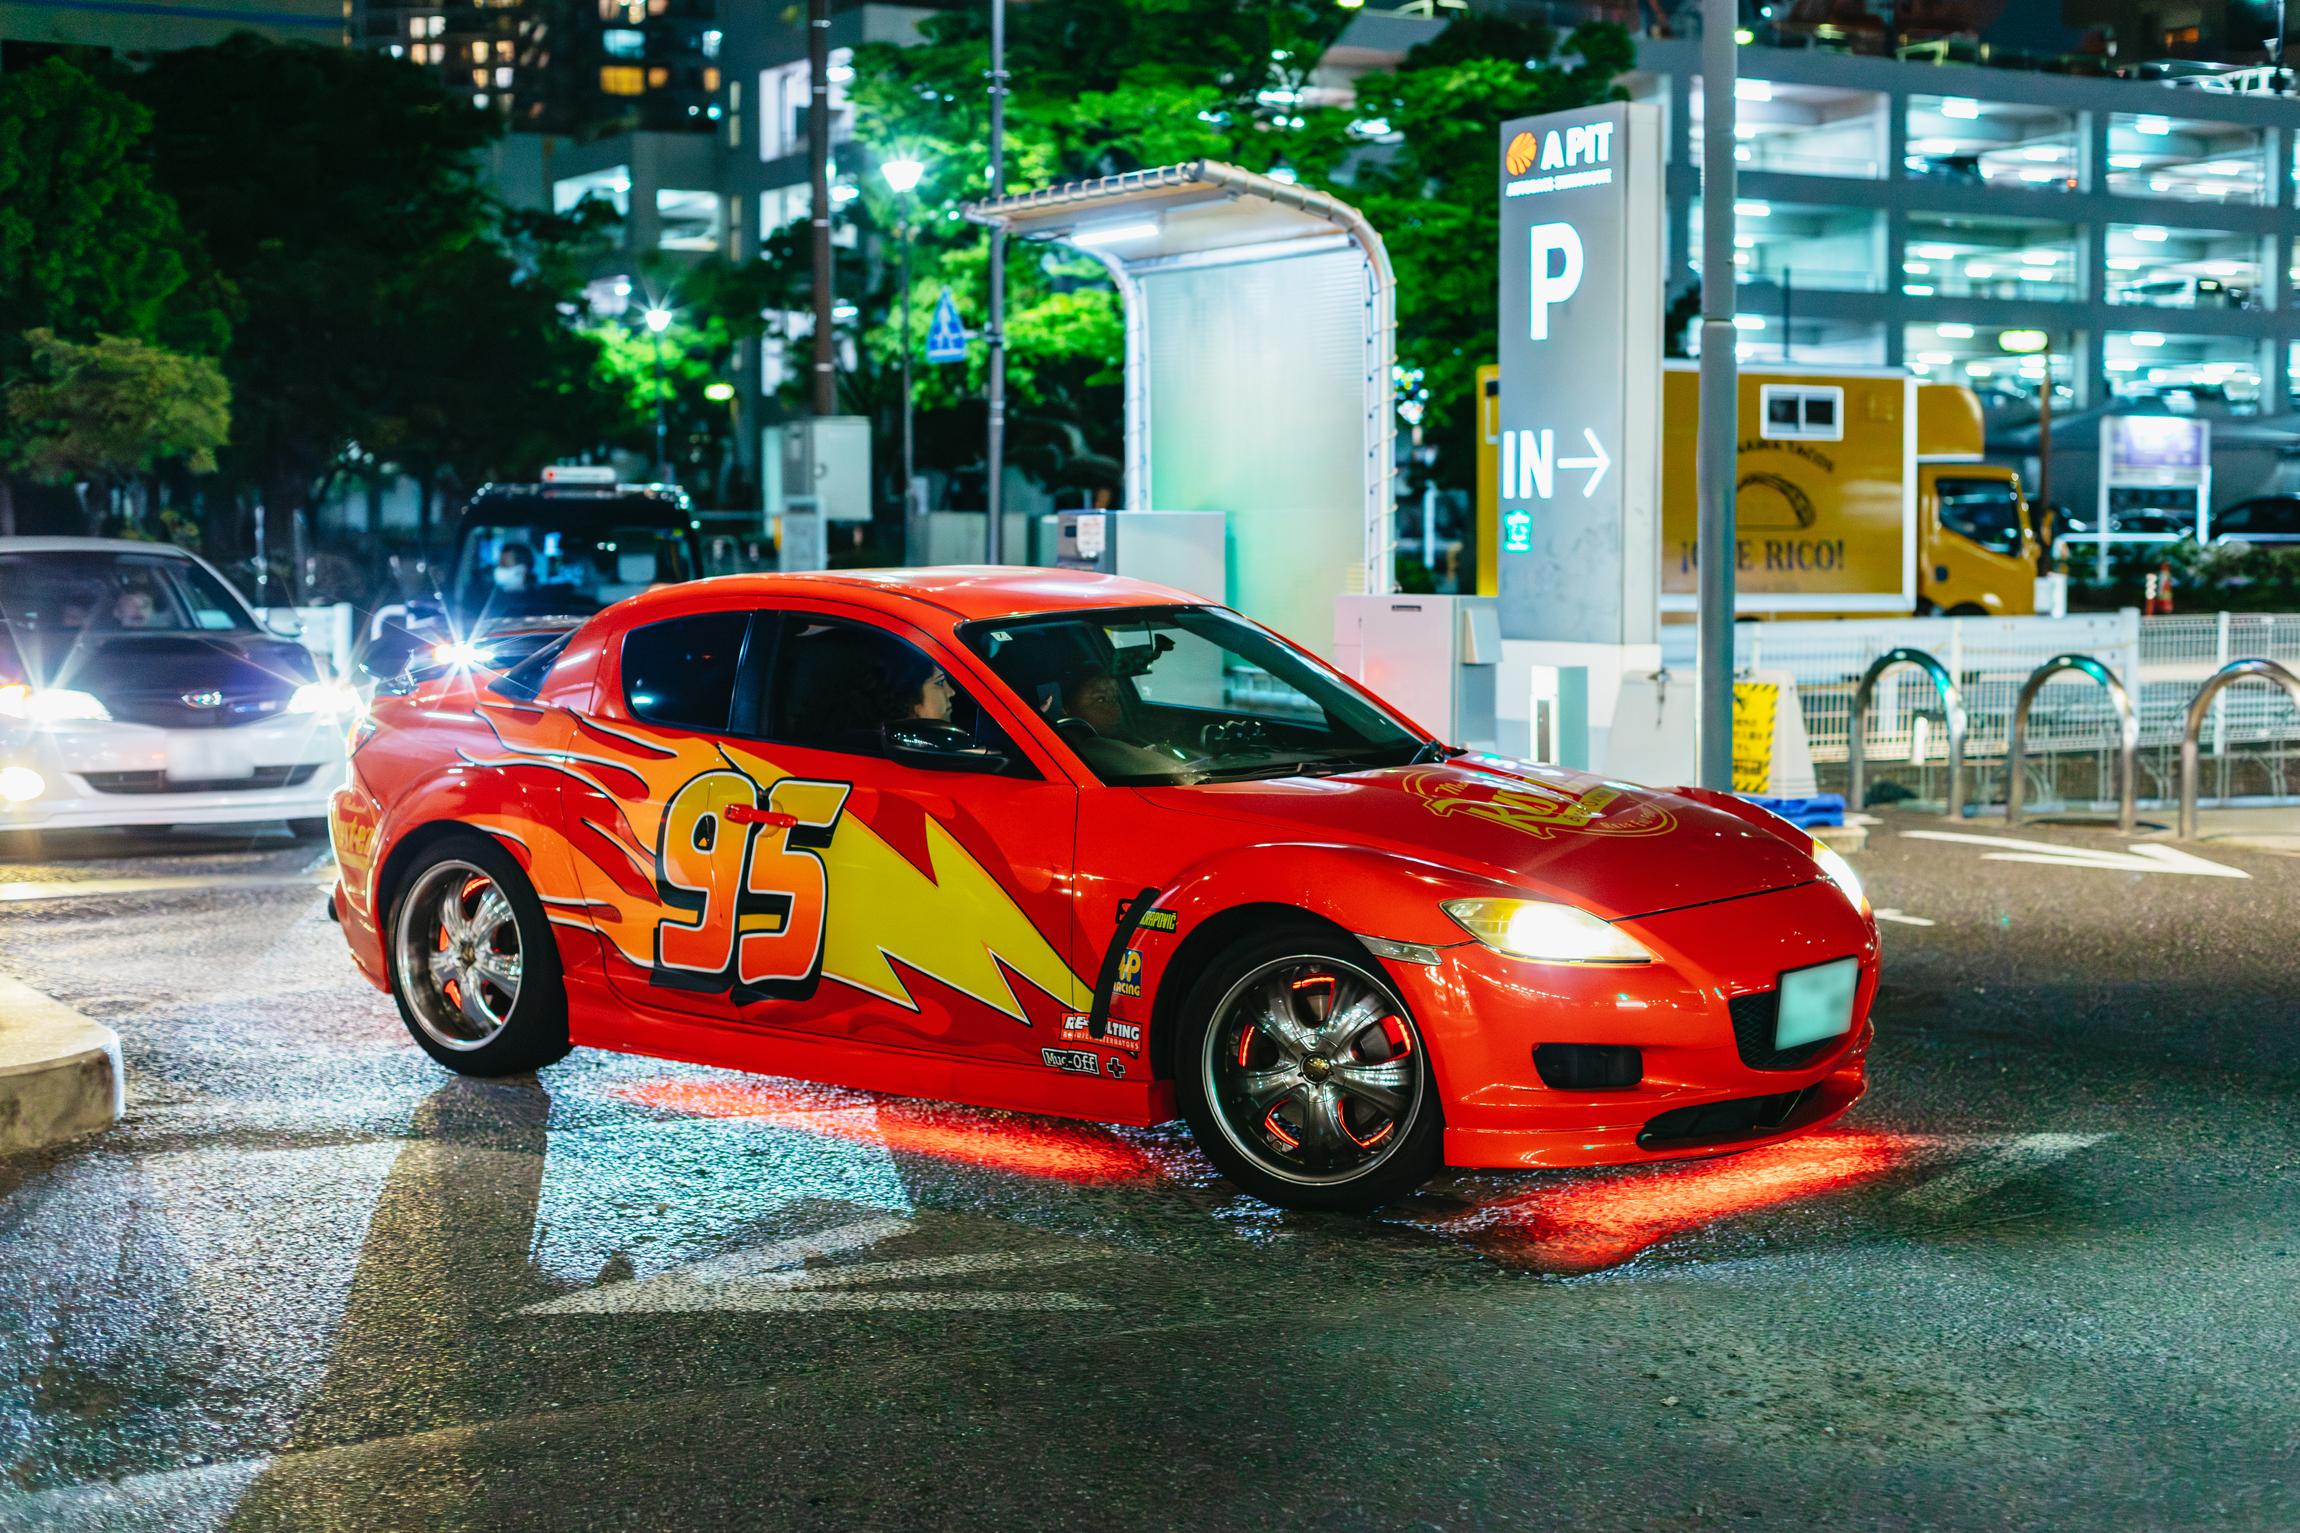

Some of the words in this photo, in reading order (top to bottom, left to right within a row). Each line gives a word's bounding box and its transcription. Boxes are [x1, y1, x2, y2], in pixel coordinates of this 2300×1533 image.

[1530, 222, 1584, 341] P
[1502, 428, 1554, 500] IN
[1766, 540, 1845, 571] RICO!
[656, 768, 853, 990] 95
[1064, 1015, 1140, 1041] RE-LTING
[1045, 1051, 1096, 1072] Muc-Off
